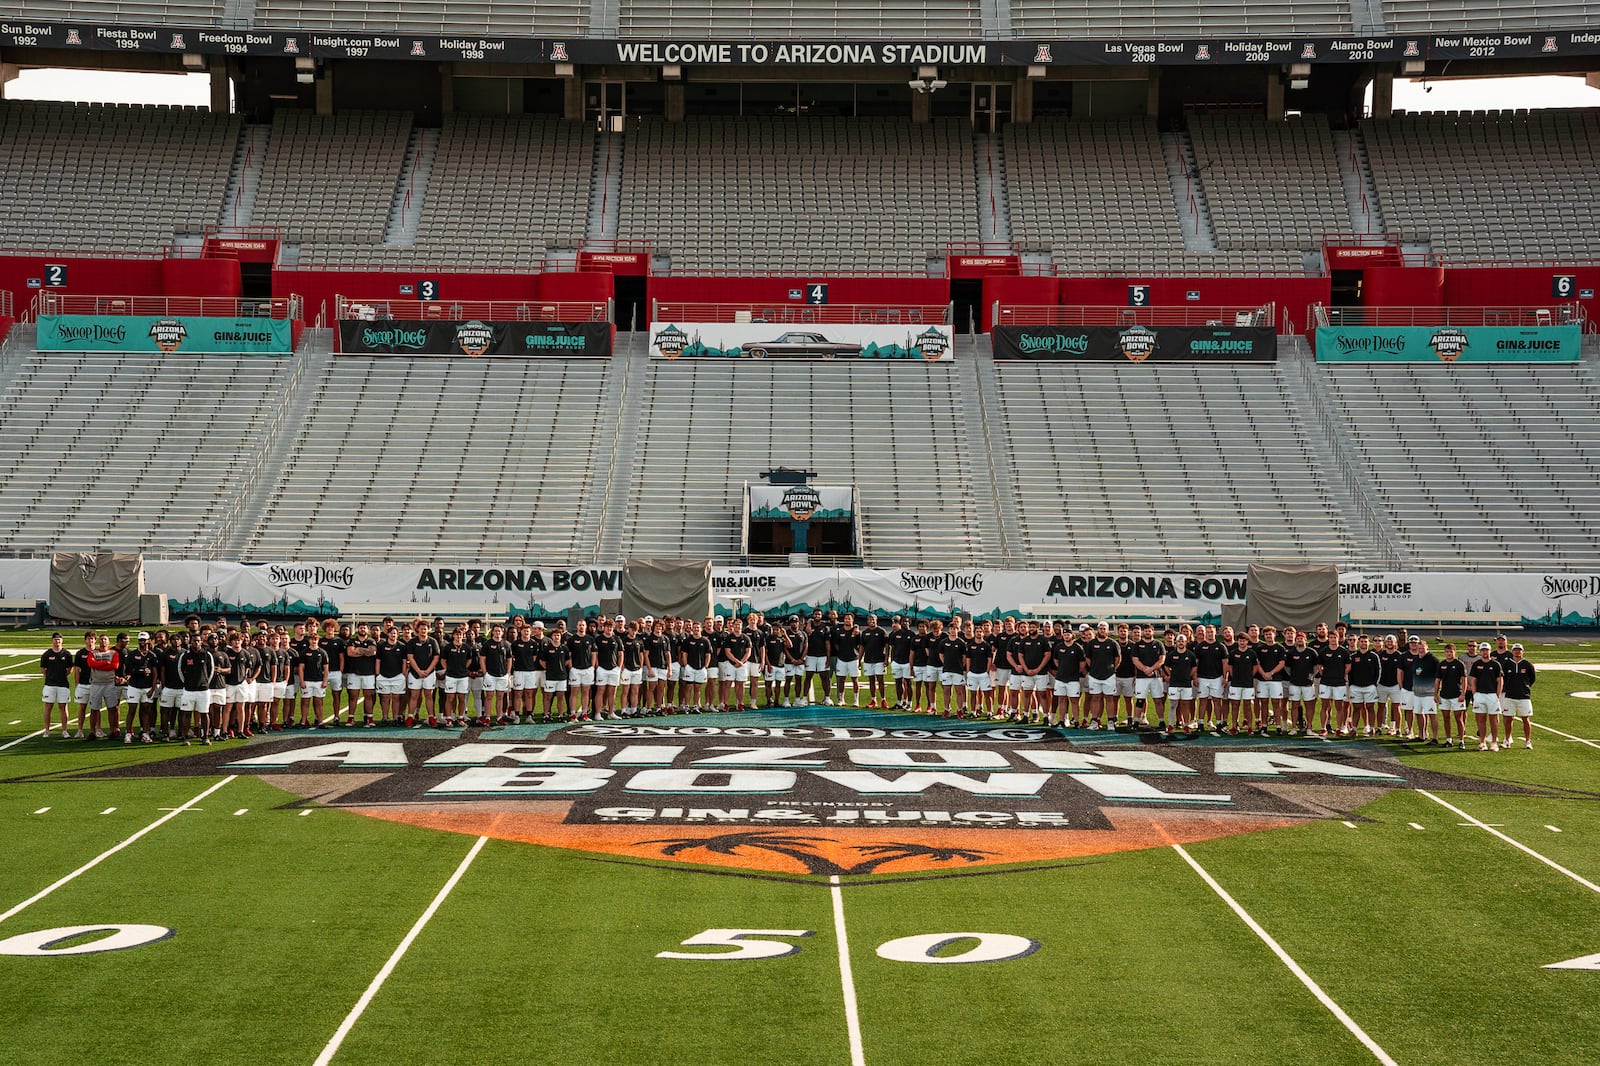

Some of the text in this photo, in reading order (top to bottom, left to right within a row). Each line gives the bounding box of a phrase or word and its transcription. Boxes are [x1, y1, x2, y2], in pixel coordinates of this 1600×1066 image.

[1, 25, 52, 36] Sun Bowl
[97, 28, 156, 40] Fiesta Bowl
[12, 36, 37, 46] 1992
[116, 39, 140, 49] 1994
[199, 32, 272, 45] Freedom Bowl
[313, 36, 400, 50] Insight.com Bowl
[1436, 35, 1532, 48] New Mexico Bowl
[224, 44, 248, 54] 1994
[440, 40, 505, 52] Holiday Bowl
[1105, 43, 1184, 55] Las Vegas Bowl
[1225, 42, 1292, 54] Holiday Bowl
[1331, 40, 1394, 50] Alamo Bowl
[1470, 46, 1495, 56] 2012
[345, 47, 368, 57] 1997
[461, 50, 484, 60] 1998
[617, 44, 986, 64] WELCOME TO ARIZONA STADIUM
[1132, 53, 1156, 62] 2008
[1246, 52, 1270, 62] 2009
[1349, 50, 1374, 60] 2010
[50, 266, 62, 281] 2
[422, 281, 433, 296] 3
[1558, 277, 1570, 293] 6
[812, 285, 823, 300] 4
[1134, 286, 1144, 302] 5
[57, 324, 126, 341] SNOOP DOGG
[150, 325, 186, 334] ARIZONA
[457, 330, 492, 339] ARIZONA
[158, 333, 180, 341] BOWL
[214, 332, 272, 342] GIN&JUICE
[362, 328, 426, 346] SNOOP DOGG
[463, 337, 486, 345] BOWL
[525, 335, 586, 346] GIN&JUICE
[917, 338, 948, 346] ARIZONA
[1019, 334, 1088, 352] SNOOP DOGG
[1120, 335, 1155, 344] ARIZONA
[1336, 335, 1406, 351] SNOOP DOGG
[1126, 342, 1150, 350] BOWL
[1190, 340, 1253, 350] GIN&JUICE
[1496, 341, 1560, 350] GIN&JUICE
[784, 494, 818, 502] ARIZONA
[268, 565, 354, 586] SNOOP DOGG
[416, 568, 547, 591] ARIZONA
[900, 571, 983, 592] SNOOP DOGG
[712, 576, 776, 588] IN&JUICE
[1046, 576, 1247, 600] ARIZONA BOW
[1542, 576, 1588, 595] SNOOP
[1339, 583, 1412, 594] GIN&JUICE
[568, 724, 1046, 742] SNOOP DOGG
[216, 741, 1407, 780] ARIZONA
[424, 766, 1235, 805] BOWL
[594, 807, 1070, 823] GIN&JUICE
